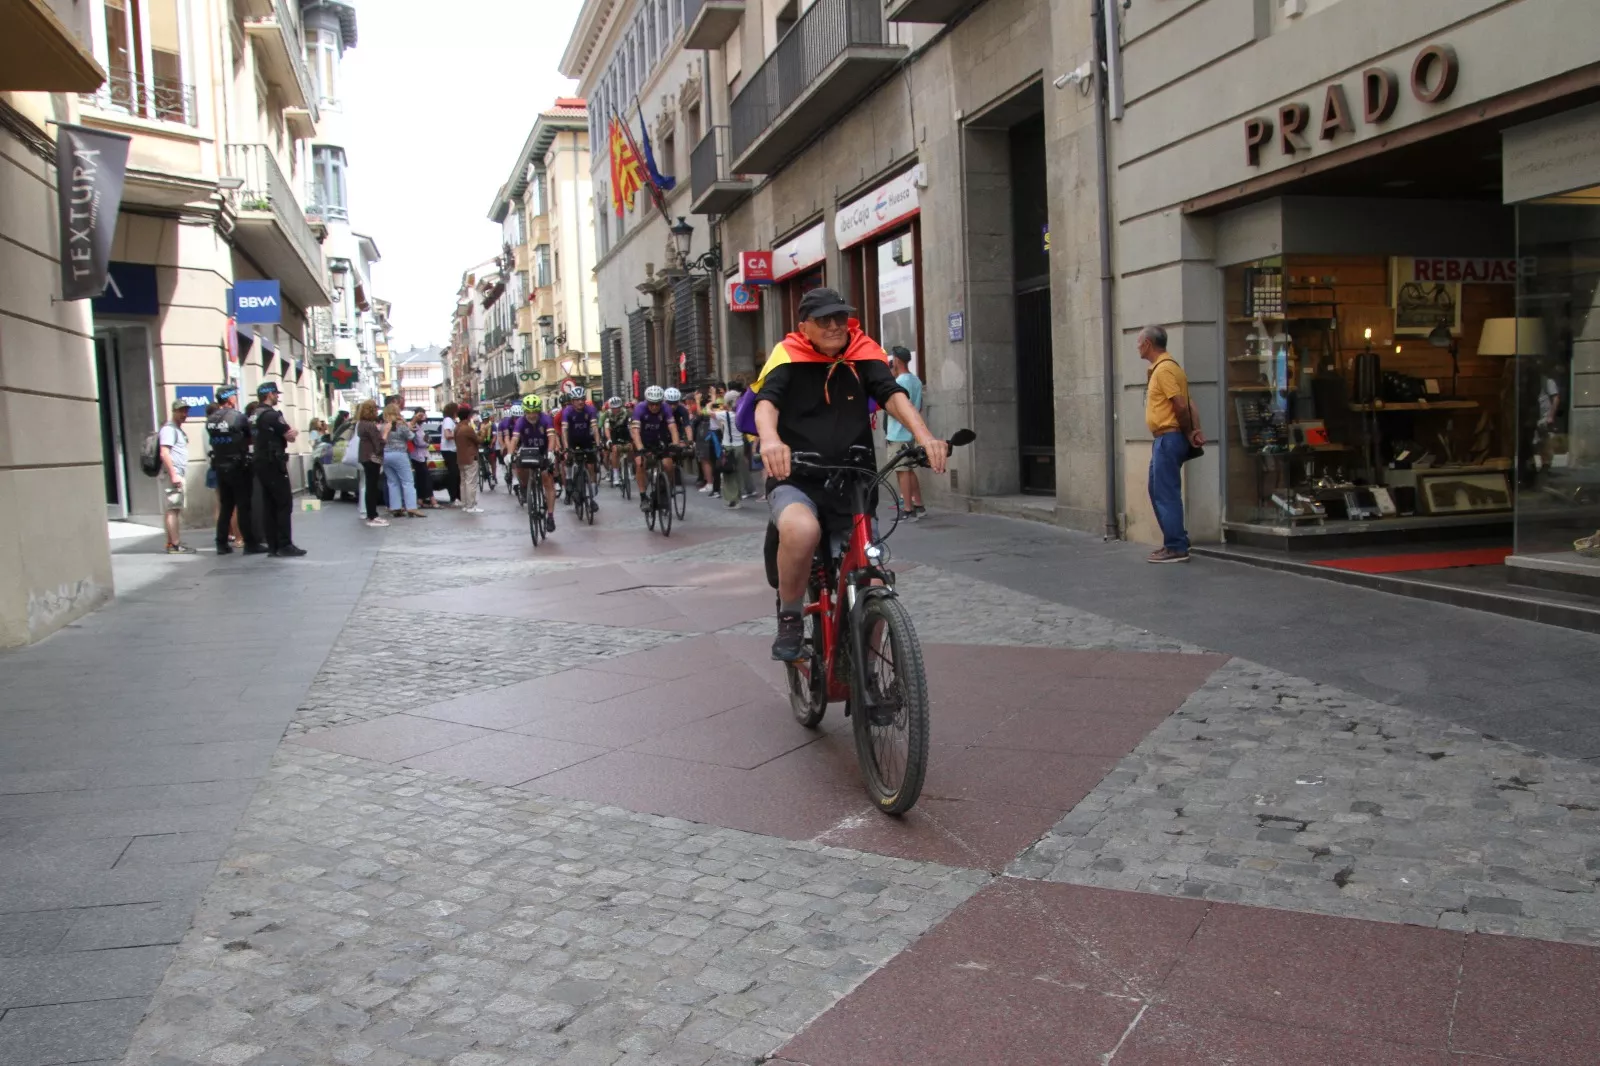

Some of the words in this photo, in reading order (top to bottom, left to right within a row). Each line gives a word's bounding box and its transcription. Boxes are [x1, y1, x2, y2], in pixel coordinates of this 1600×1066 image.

[1244, 44, 1459, 167] PRADO
[69, 149, 100, 281] TEXTURA
[747, 258, 767, 269] CA
[1415, 259, 1517, 281] REBAJAS
[239, 295, 276, 308] BBVA
